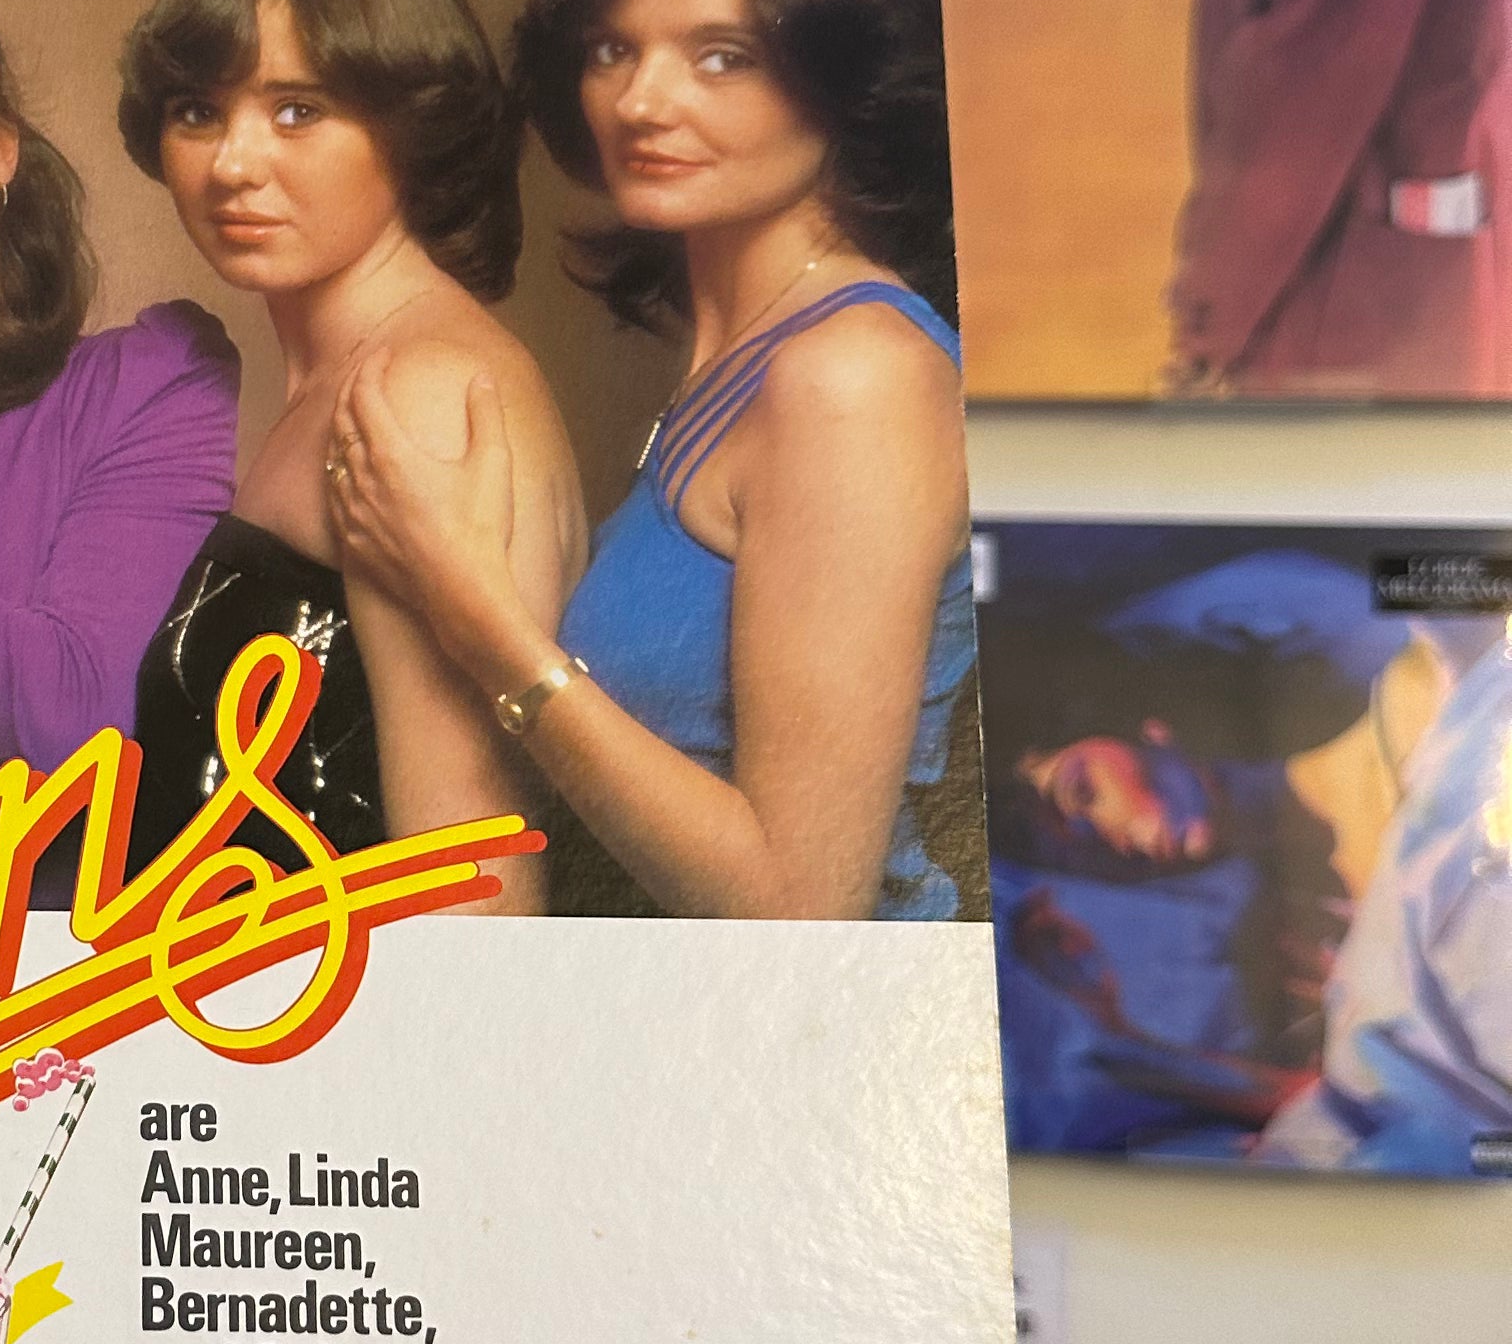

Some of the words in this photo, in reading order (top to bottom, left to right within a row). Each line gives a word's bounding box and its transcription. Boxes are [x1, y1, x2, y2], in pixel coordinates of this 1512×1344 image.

[139, 1102, 218, 1142] are
[140, 1149, 281, 1215] Anne,
[288, 1153, 420, 1208] Linda
[141, 1213, 376, 1279] Maureen,
[141, 1276, 437, 1344] Bernadette,
